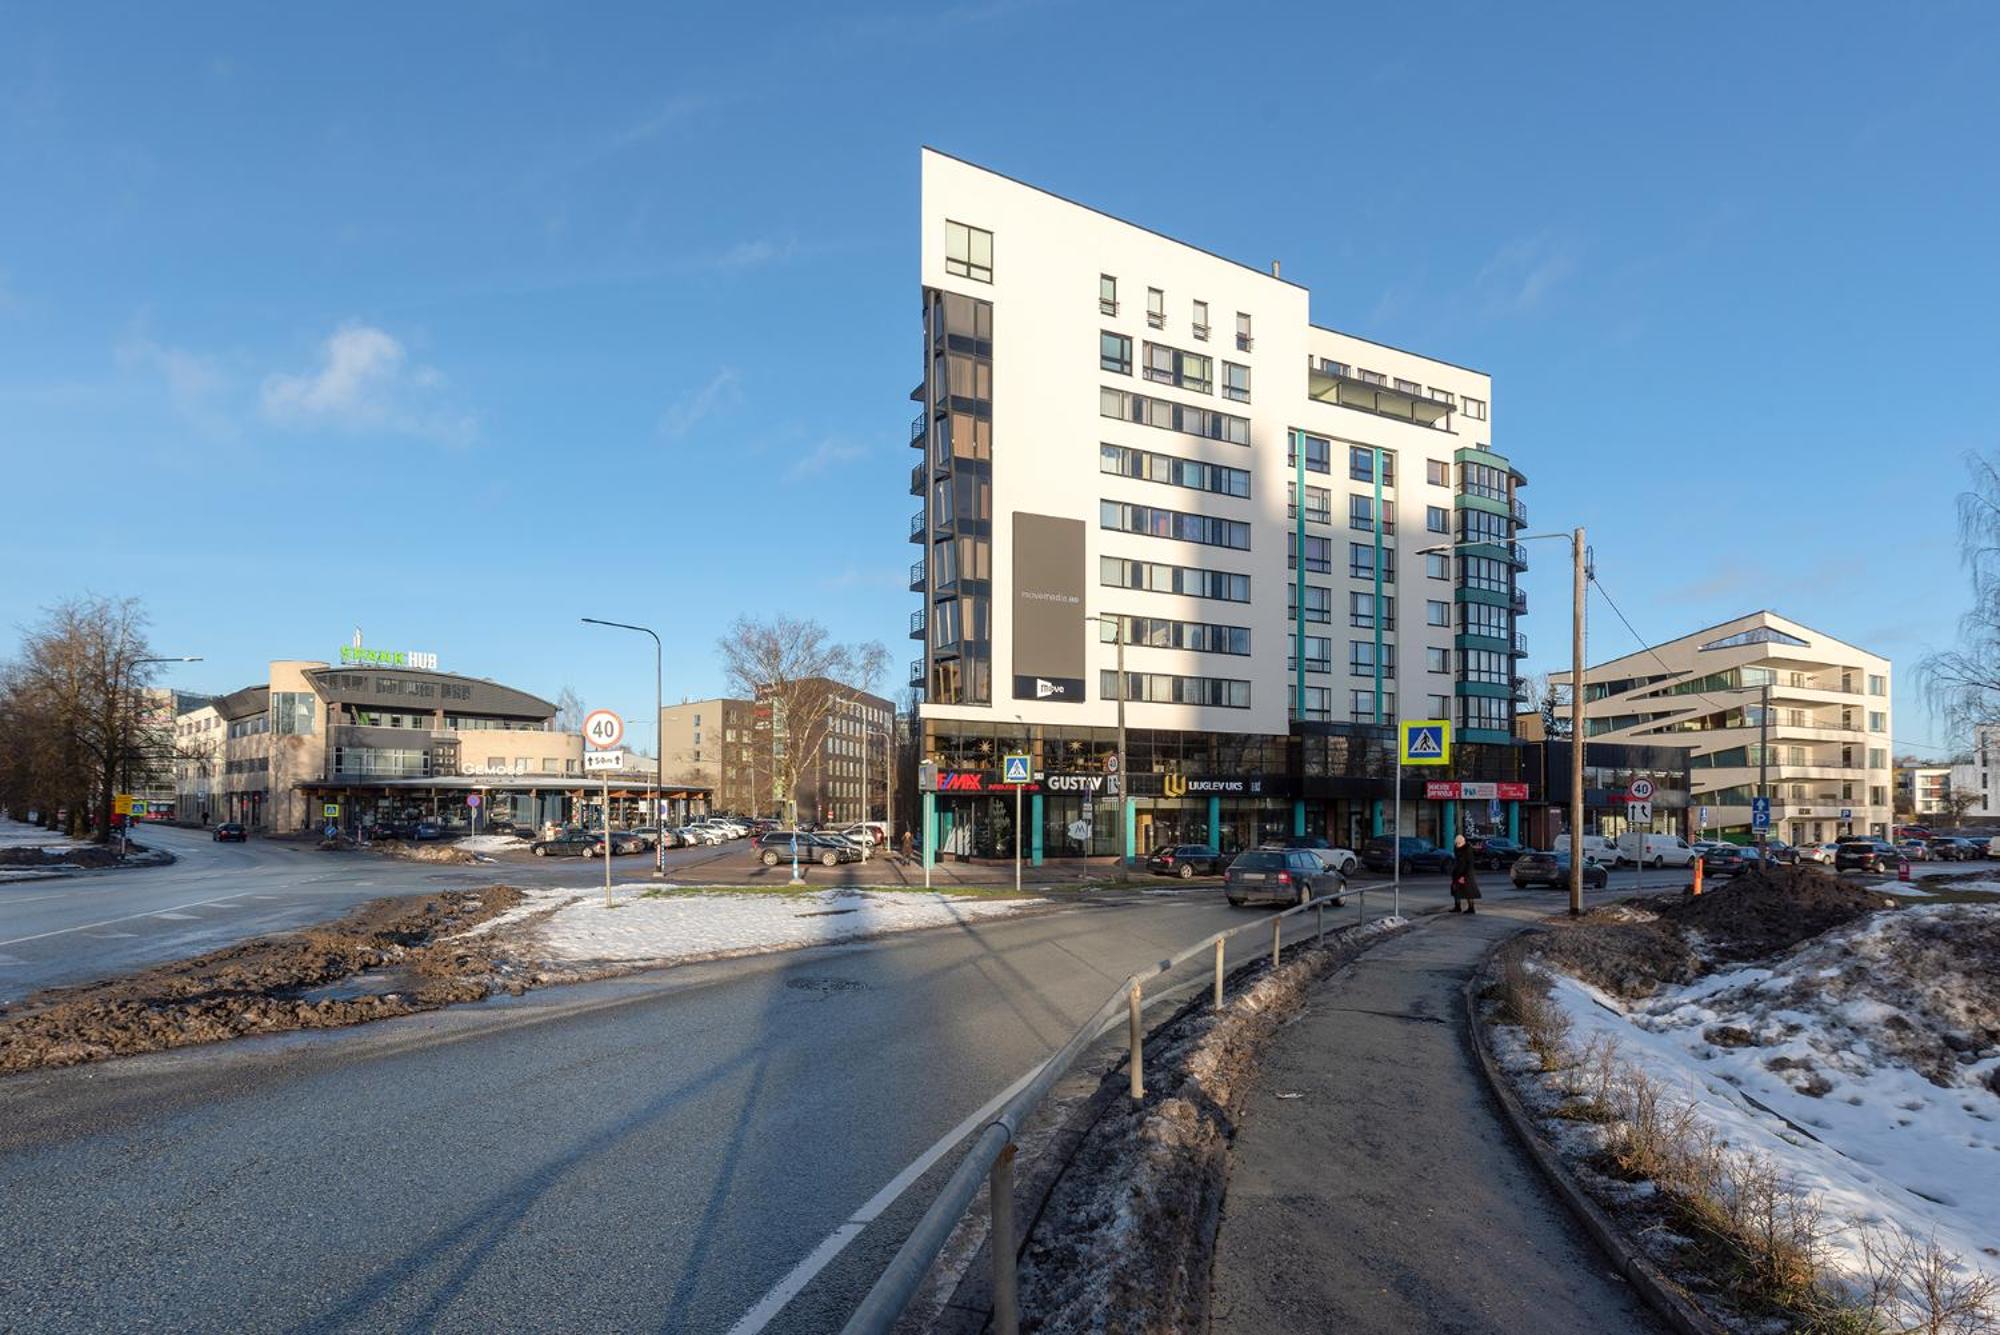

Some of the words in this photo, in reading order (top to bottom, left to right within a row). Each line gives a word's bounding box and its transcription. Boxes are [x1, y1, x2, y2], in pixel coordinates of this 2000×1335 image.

[408, 651, 437, 668] HUB
[593, 720, 614, 738] 40
[1048, 776, 1102, 791] GUSTAV
[1635, 784, 1649, 795] 40
